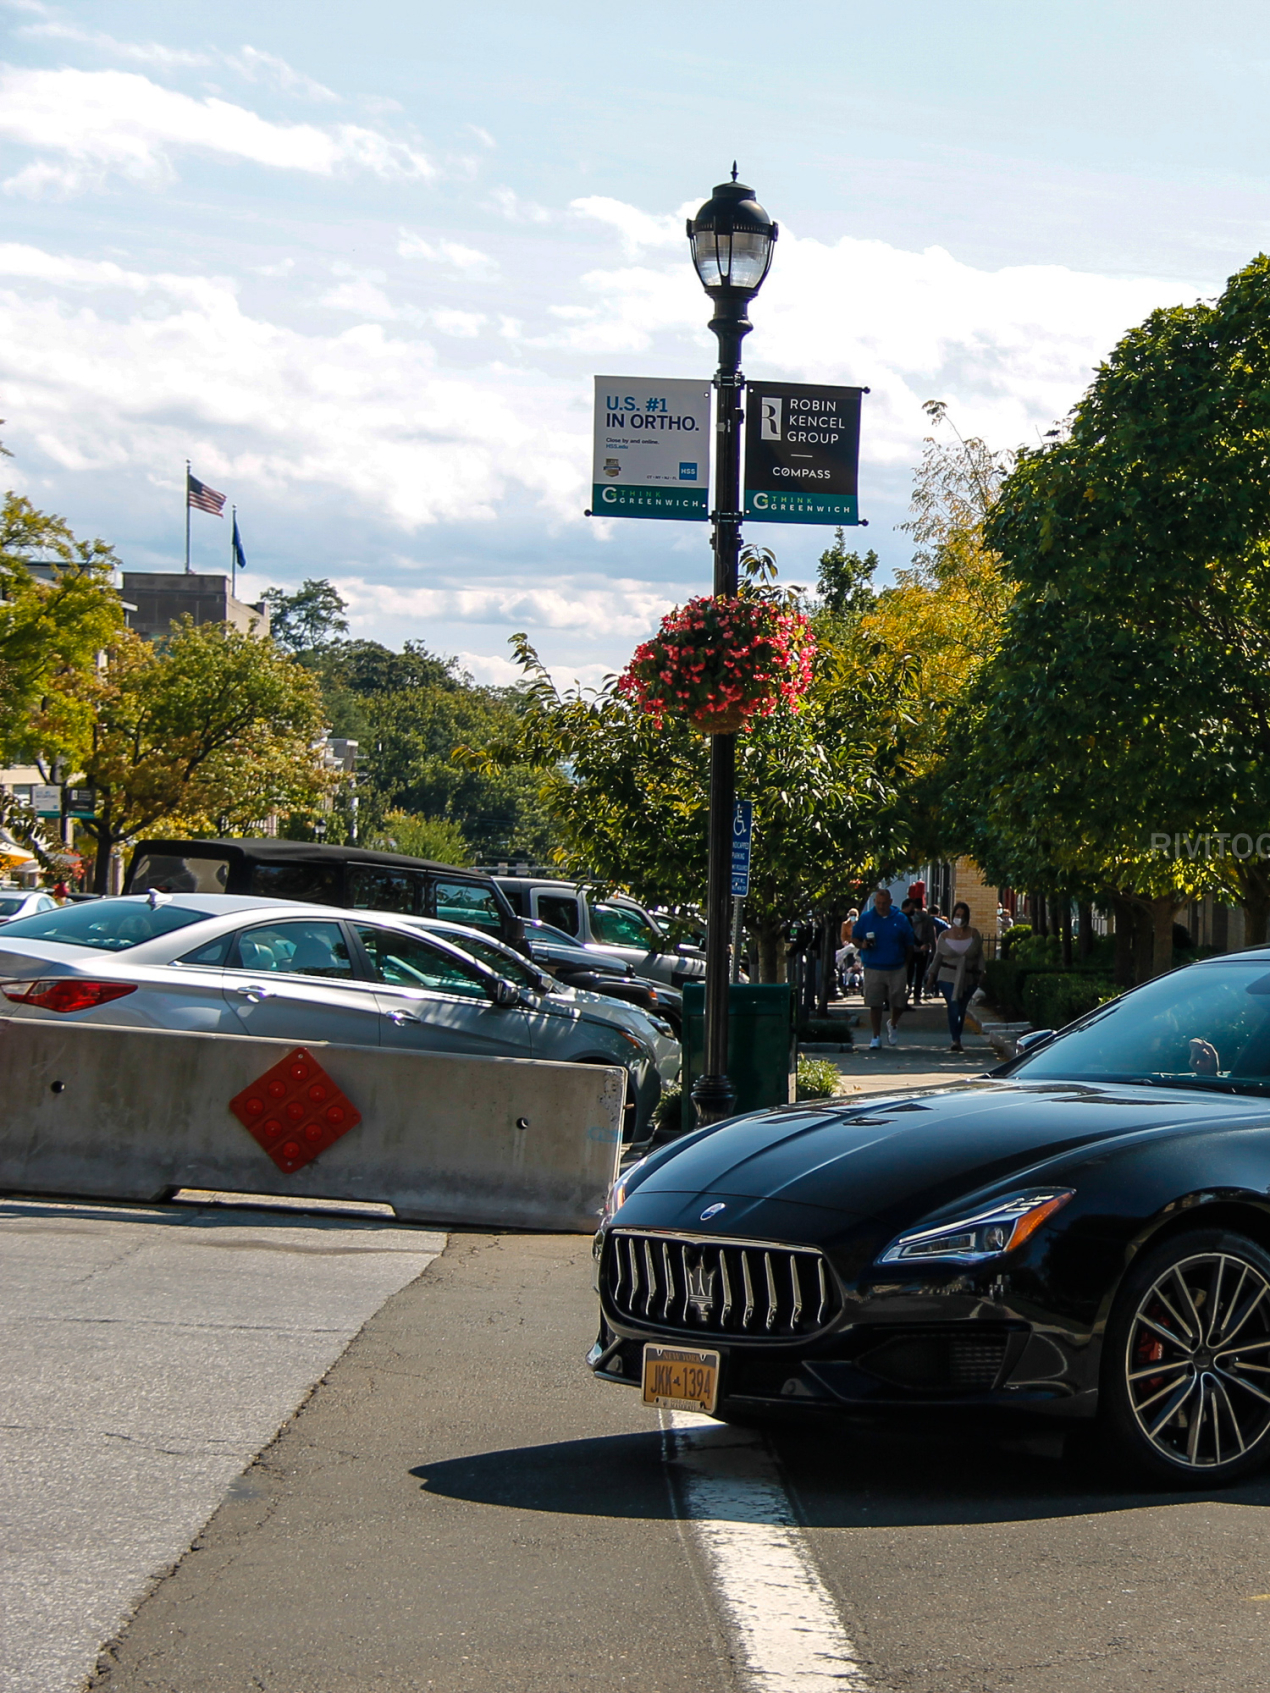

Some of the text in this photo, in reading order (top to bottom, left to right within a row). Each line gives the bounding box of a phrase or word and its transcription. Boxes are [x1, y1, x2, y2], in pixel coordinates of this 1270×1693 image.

[606, 395, 668, 413] U.S. #1
[790, 398, 836, 412] ROBIN
[606, 413, 700, 431] IN ORTHO.
[789, 415, 845, 429] KENCEL
[787, 431, 839, 444] GROUP
[772, 466, 831, 479] COMPASS
[619, 497, 699, 507] GREENWICH
[771, 503, 850, 513] GREENWICH
[662, 1351, 700, 1362] NEW YORK
[650, 1365, 711, 1399] JKK 1394
